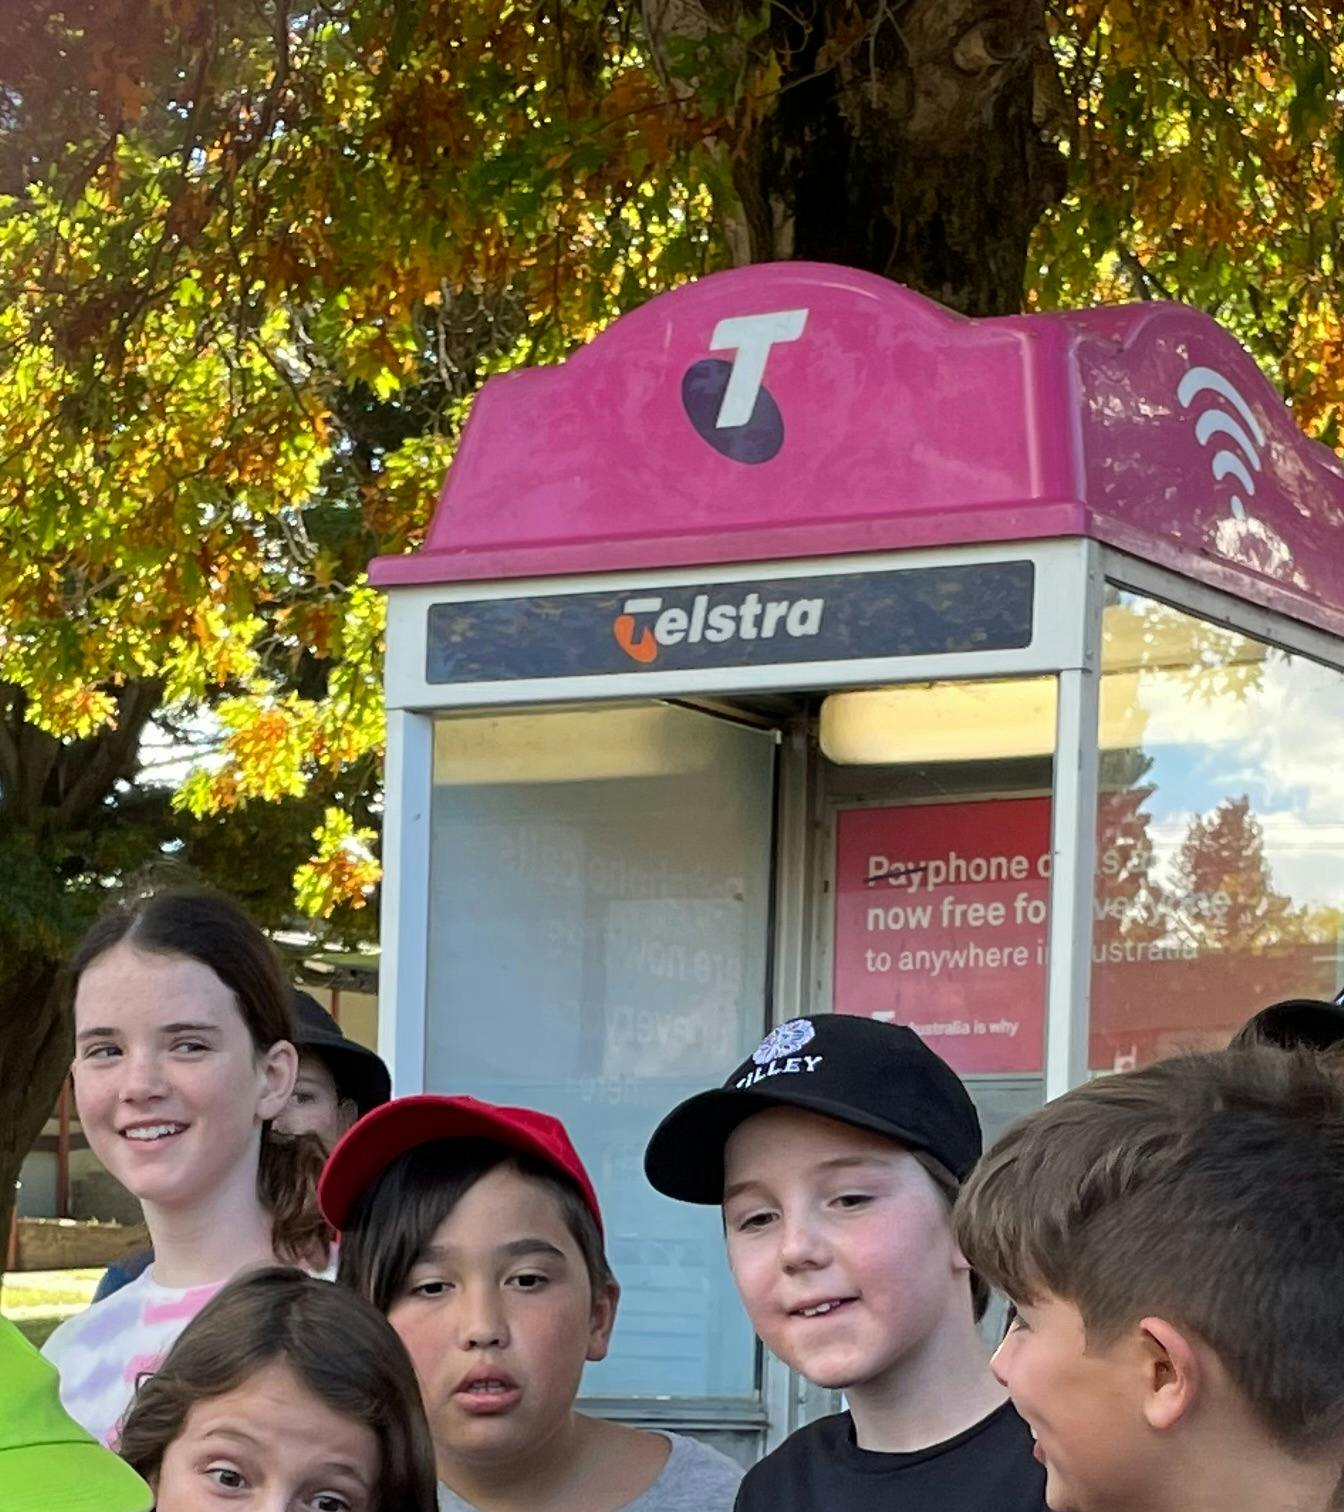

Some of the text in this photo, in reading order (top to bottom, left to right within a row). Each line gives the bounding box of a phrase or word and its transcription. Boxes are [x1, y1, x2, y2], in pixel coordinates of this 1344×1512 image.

[709, 308, 809, 429] T
[614, 593, 824, 663] Telstra
[864, 852, 1029, 893] Payphone
[867, 905, 932, 931] now
[940, 896, 1006, 928] free
[1014, 893, 1047, 925] fo
[865, 948, 892, 973] to
[898, 941, 1029, 977] anywhere
[1093, 940, 1199, 963] ustralia
[989, 1018, 1019, 1038] why
